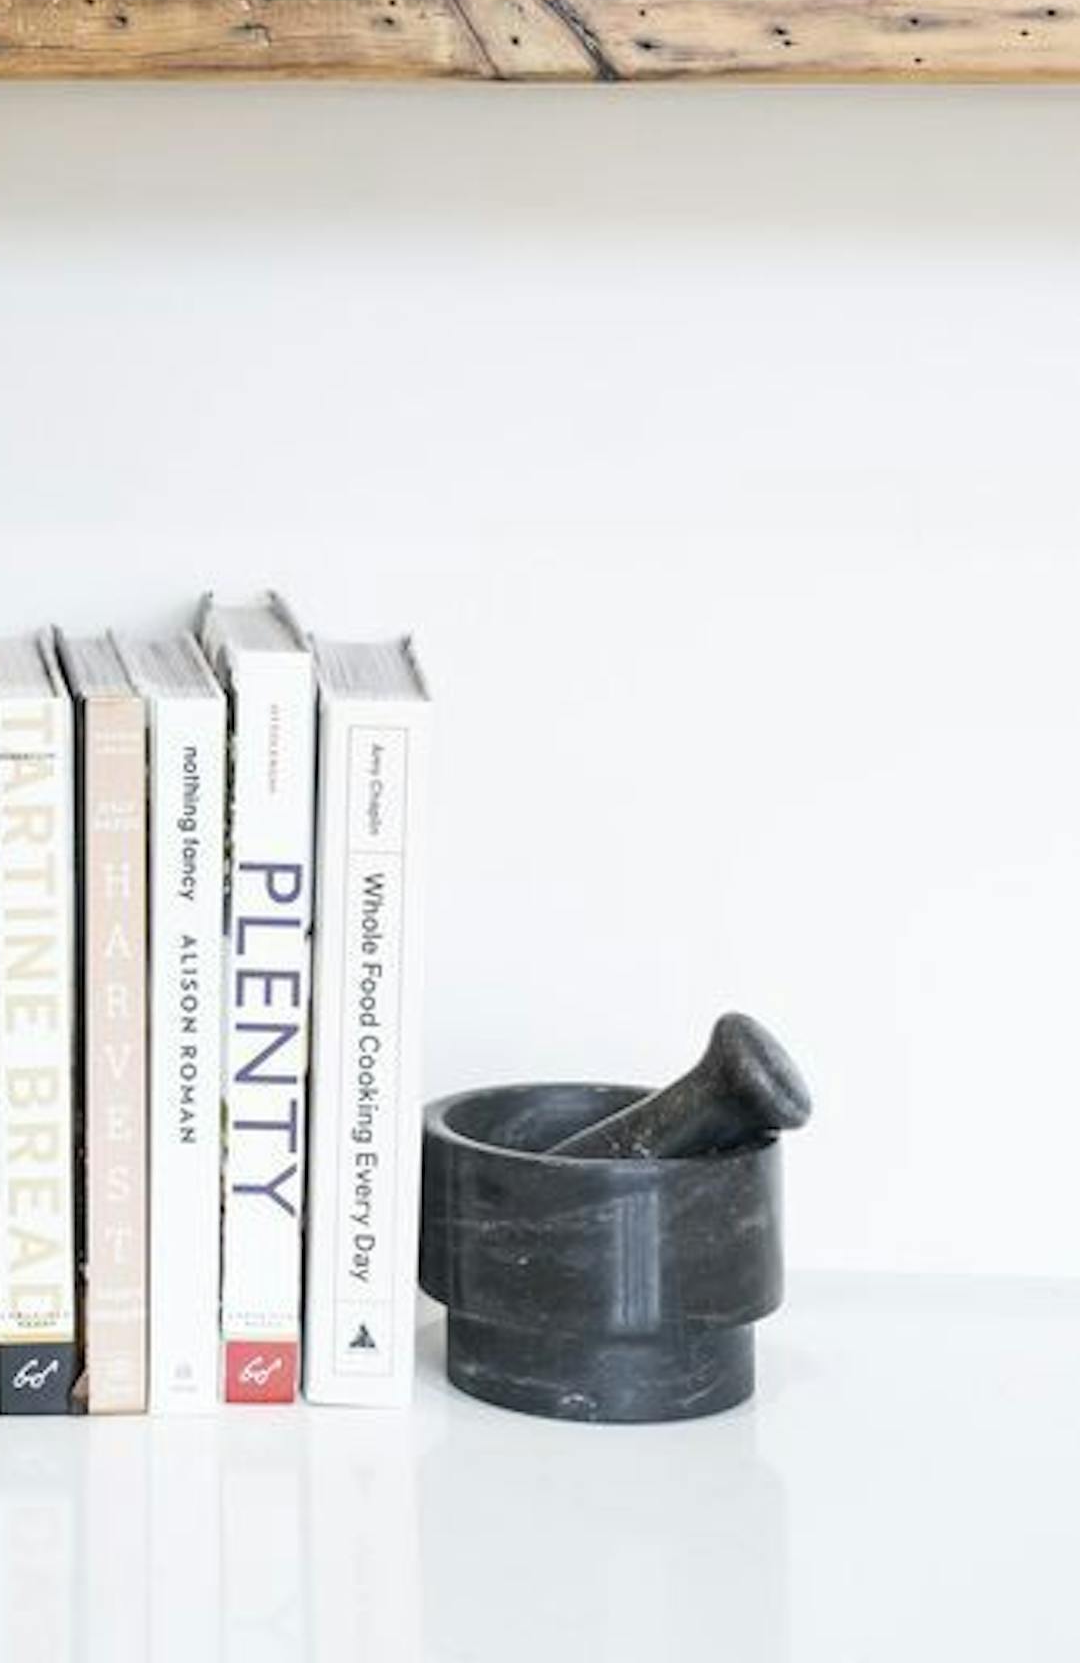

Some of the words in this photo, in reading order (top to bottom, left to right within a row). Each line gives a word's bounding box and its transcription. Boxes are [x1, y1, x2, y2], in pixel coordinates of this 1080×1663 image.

[177, 746, 200, 833] nothing
[1, 702, 58, 1032] TARTINE
[179, 839, 200, 901] fancy
[361, 872, 385, 955] Whole
[180, 935, 198, 1034] ALISON
[358, 964, 382, 1027] Food
[103, 861, 132, 1265] HARVEST
[232, 862, 303, 1217] PLENTY
[179, 1045, 198, 1144] ROMAN
[351, 1035, 381, 1144] Cooking
[350, 1152, 379, 1226] Every
[349, 1235, 376, 1283] Day
